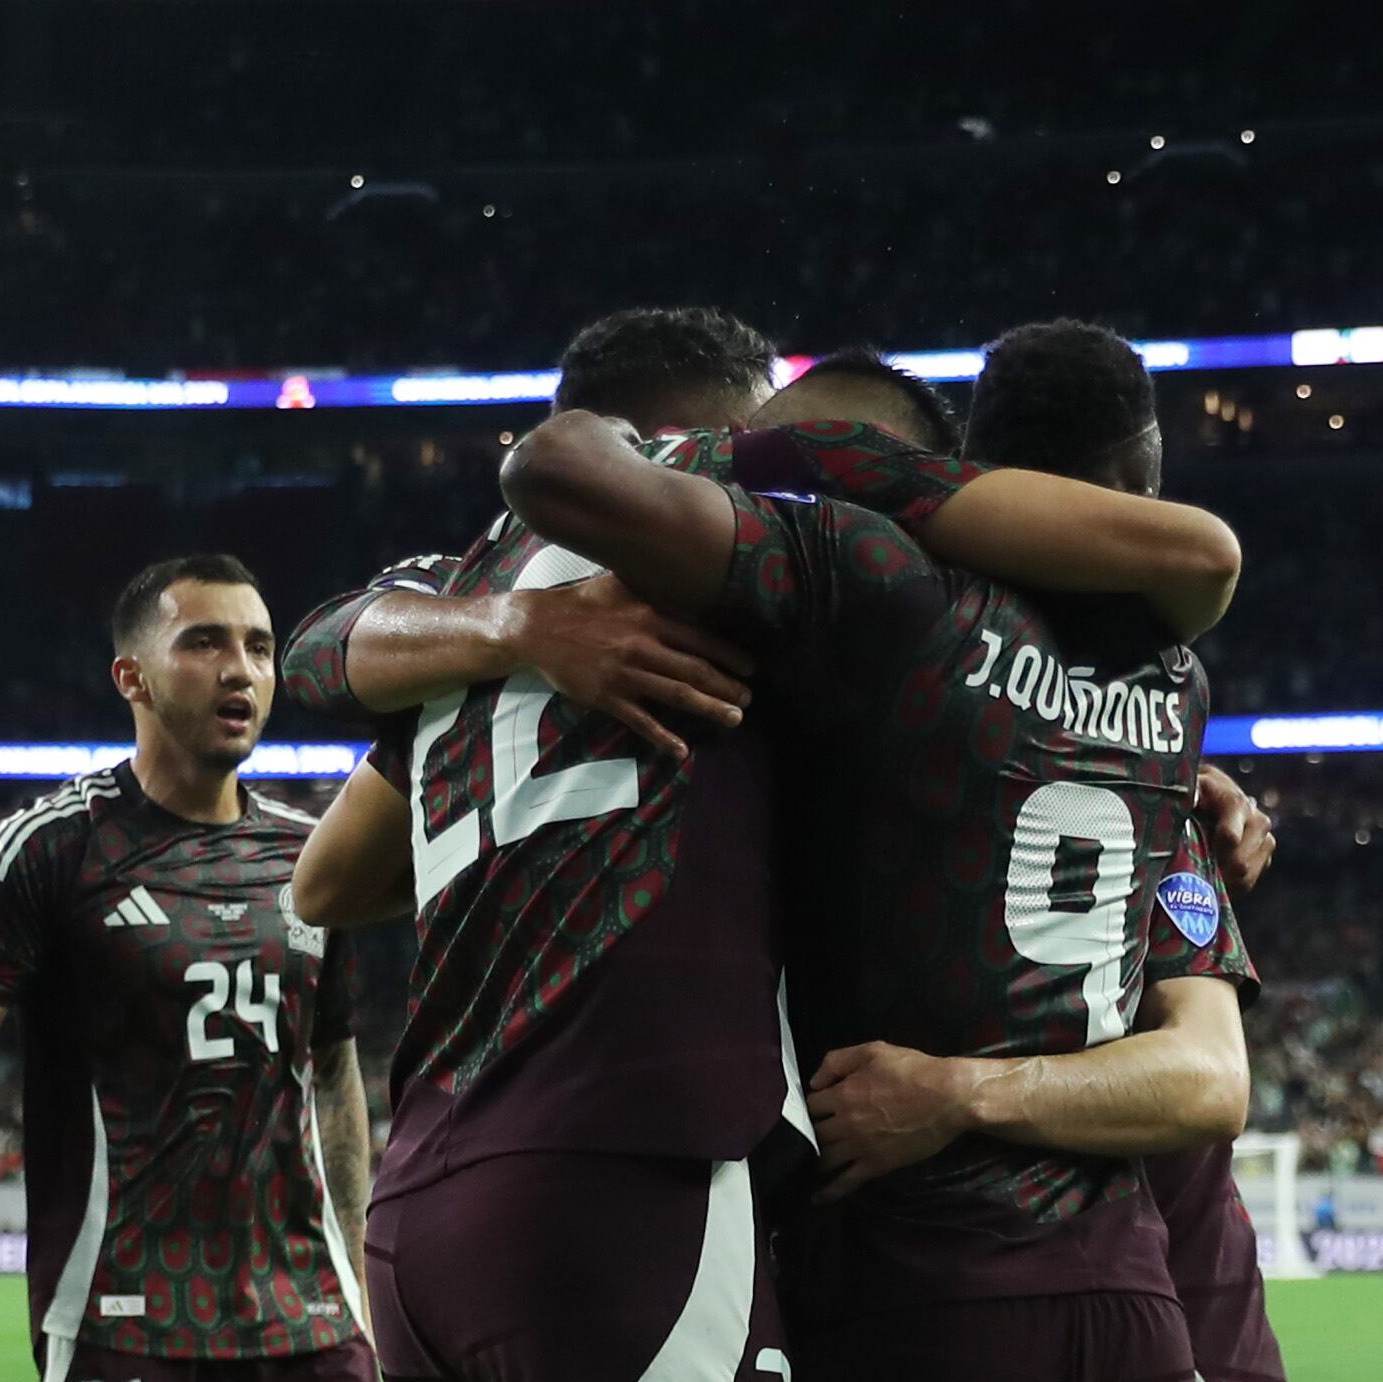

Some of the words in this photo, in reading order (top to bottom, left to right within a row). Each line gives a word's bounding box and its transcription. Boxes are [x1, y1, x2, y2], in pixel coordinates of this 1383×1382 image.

[1005, 781, 1136, 1046] 9
[1167, 891, 1212, 908] VIBRA
[184, 960, 280, 1060] 24
